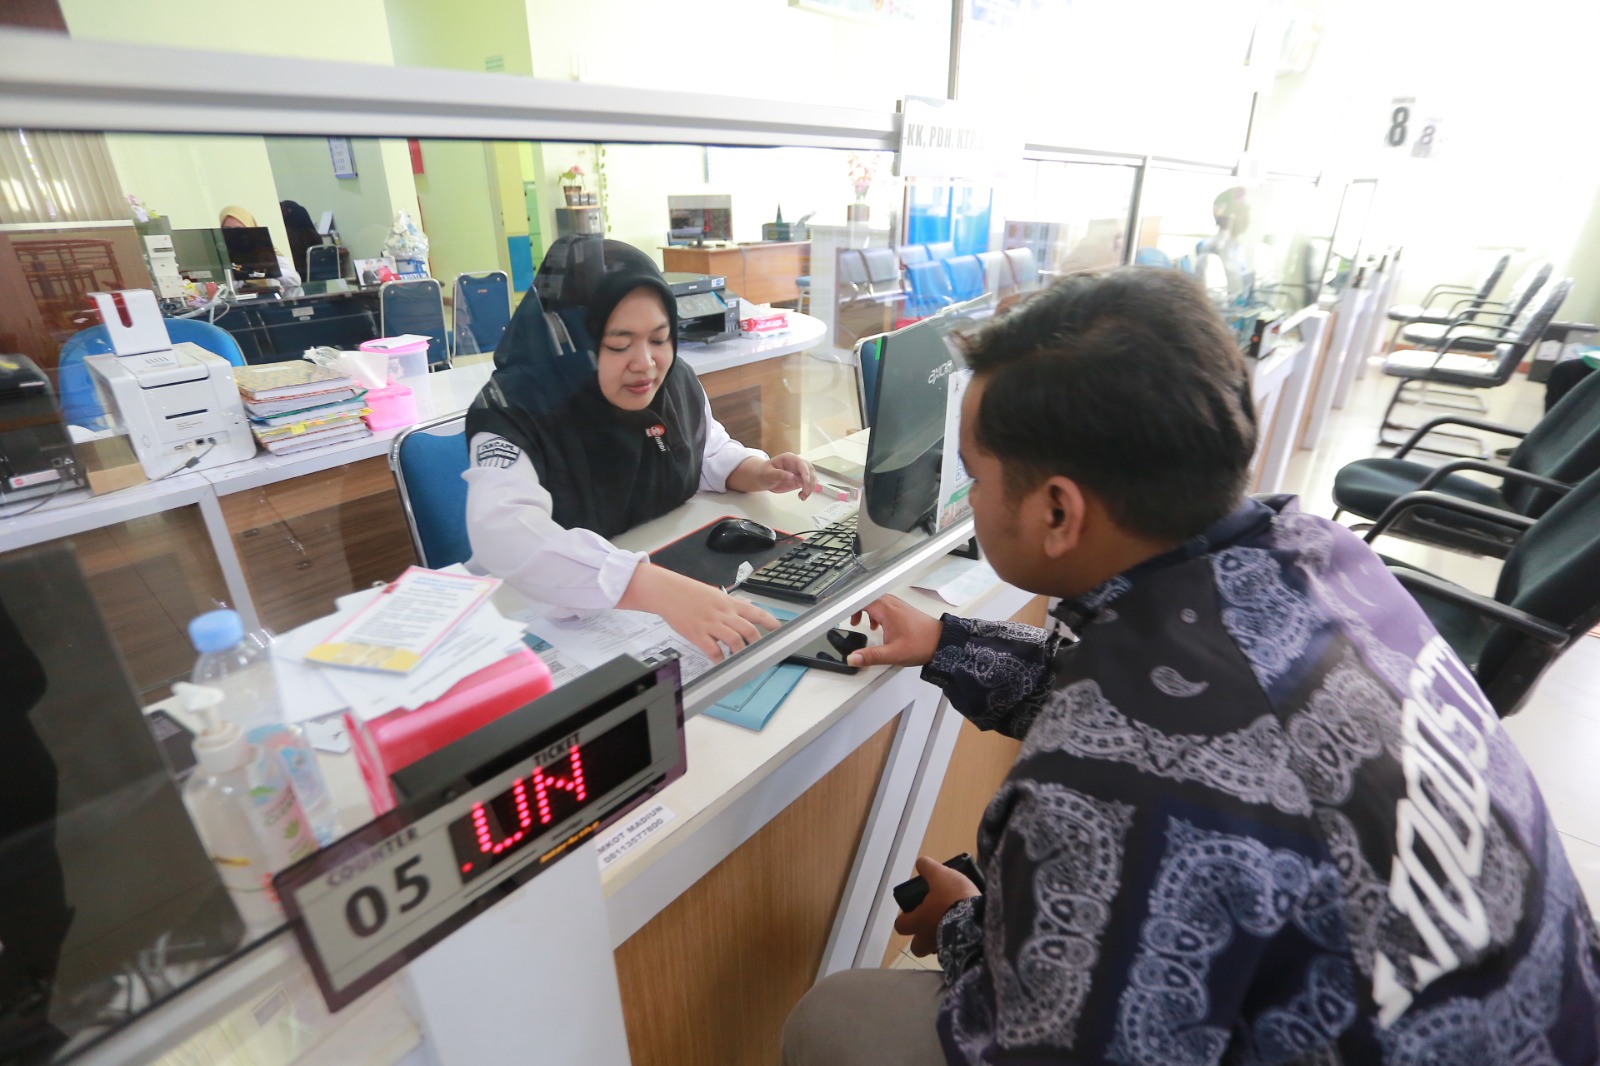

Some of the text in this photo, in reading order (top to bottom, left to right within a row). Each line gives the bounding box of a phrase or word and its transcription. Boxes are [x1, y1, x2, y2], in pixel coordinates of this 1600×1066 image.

[1387, 106, 1410, 147] 8
[533, 731, 580, 766] TICKET
[626, 805, 664, 833] MADIUN
[327, 826, 417, 887] COUNTER
[344, 854, 431, 938] 05
